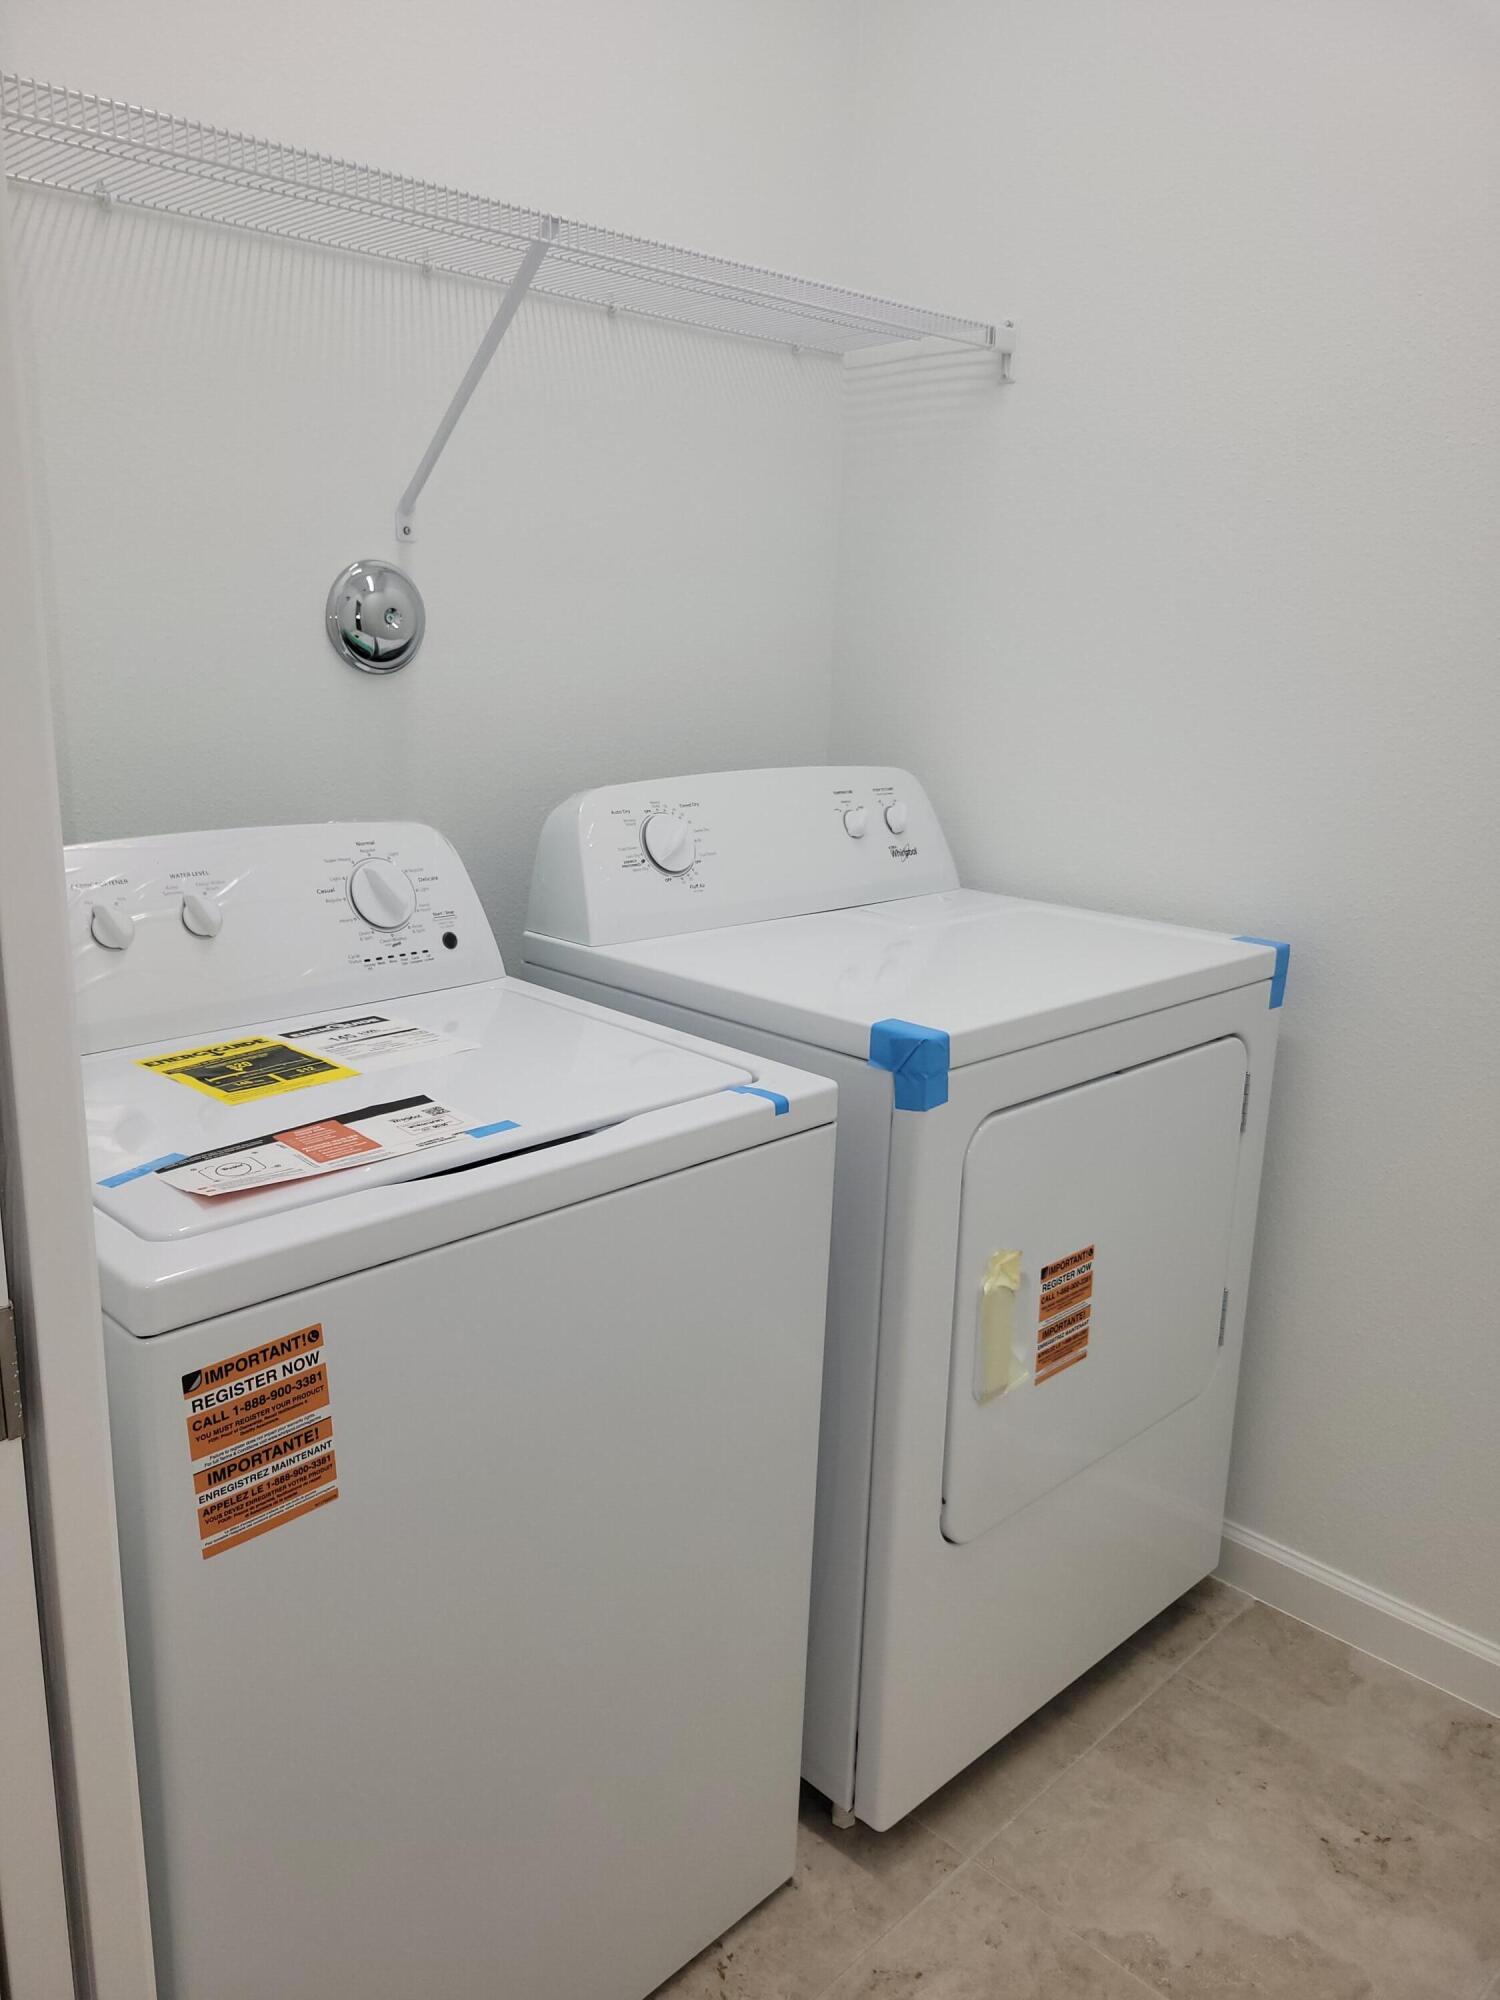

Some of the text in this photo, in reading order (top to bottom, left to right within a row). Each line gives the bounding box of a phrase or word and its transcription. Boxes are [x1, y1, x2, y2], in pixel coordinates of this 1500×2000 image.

[1041, 1291, 1055, 1304] CALL
[1042, 1262, 1091, 1292] REGISTER NOW
[191, 1351, 320, 1413] REGISTER NOW
[203, 1333, 306, 1385] IMPORTANT!
[192, 1371, 322, 1432] CALL 1-888-900-3381
[196, 1385, 324, 1442] YOU MUST REGISTER YOUR PRODUCT
[198, 1467, 269, 1505] ENREGISTREZ
[271, 1439, 332, 1473] MAINTENANT
[207, 1427, 319, 1486] IMPORTANTE!
[202, 1490, 249, 1518] APPELEZ
[251, 1484, 263, 1496] LE
[266, 1454, 331, 1489] 1-888-900-3381
[205, 1513, 222, 1525] VOUS
[223, 1503, 244, 1517] DEVEZ
[288, 1474, 307, 1487] VOTRE
